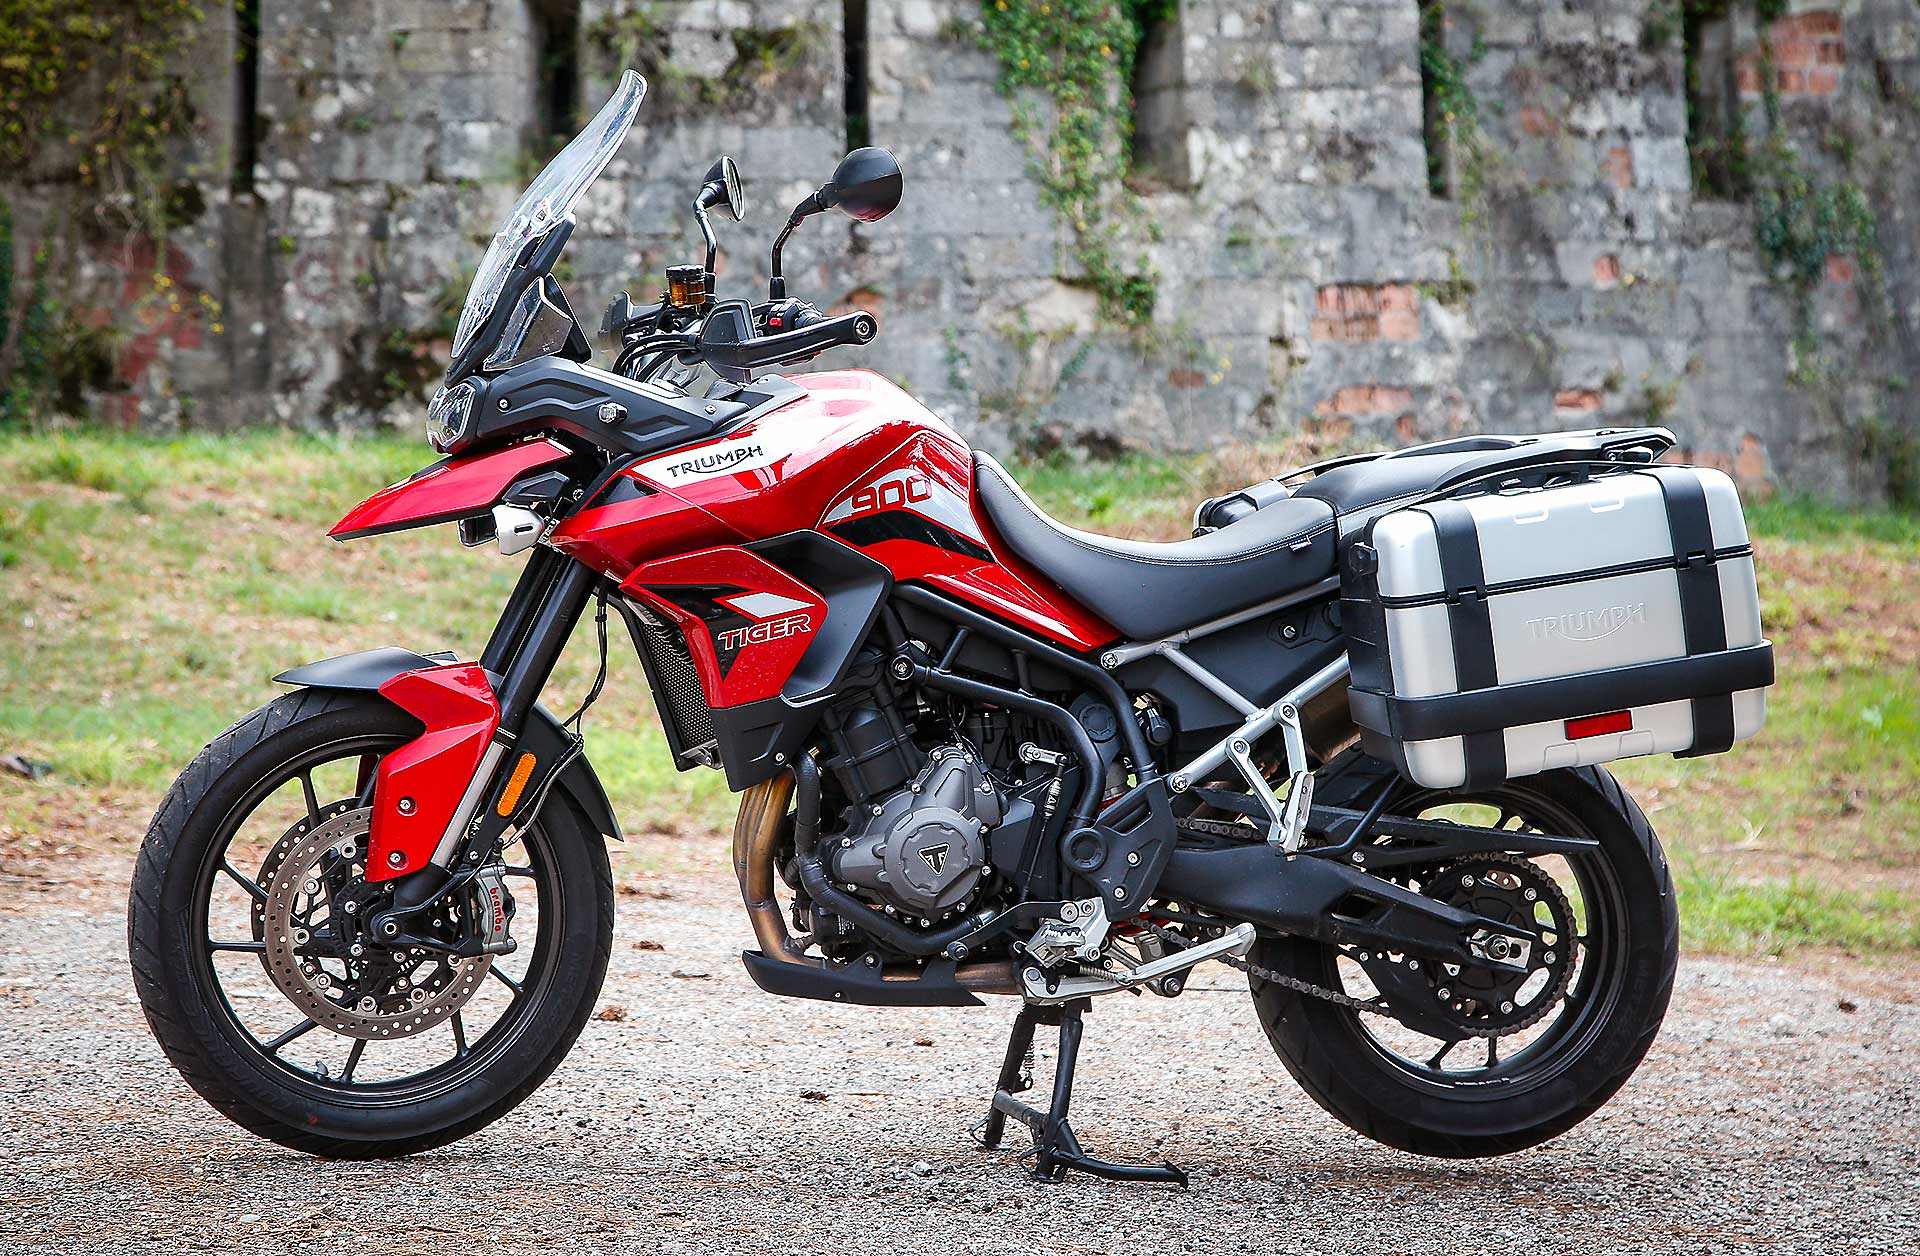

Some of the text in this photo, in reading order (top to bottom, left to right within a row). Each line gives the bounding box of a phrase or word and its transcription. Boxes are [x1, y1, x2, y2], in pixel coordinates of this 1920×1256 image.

[667, 446, 764, 478] TRIUMPH
[852, 474, 932, 511] 900
[718, 614, 811, 650] TIGER
[1526, 602, 1647, 641] TRIUMPH
[490, 887, 505, 932] brembo
